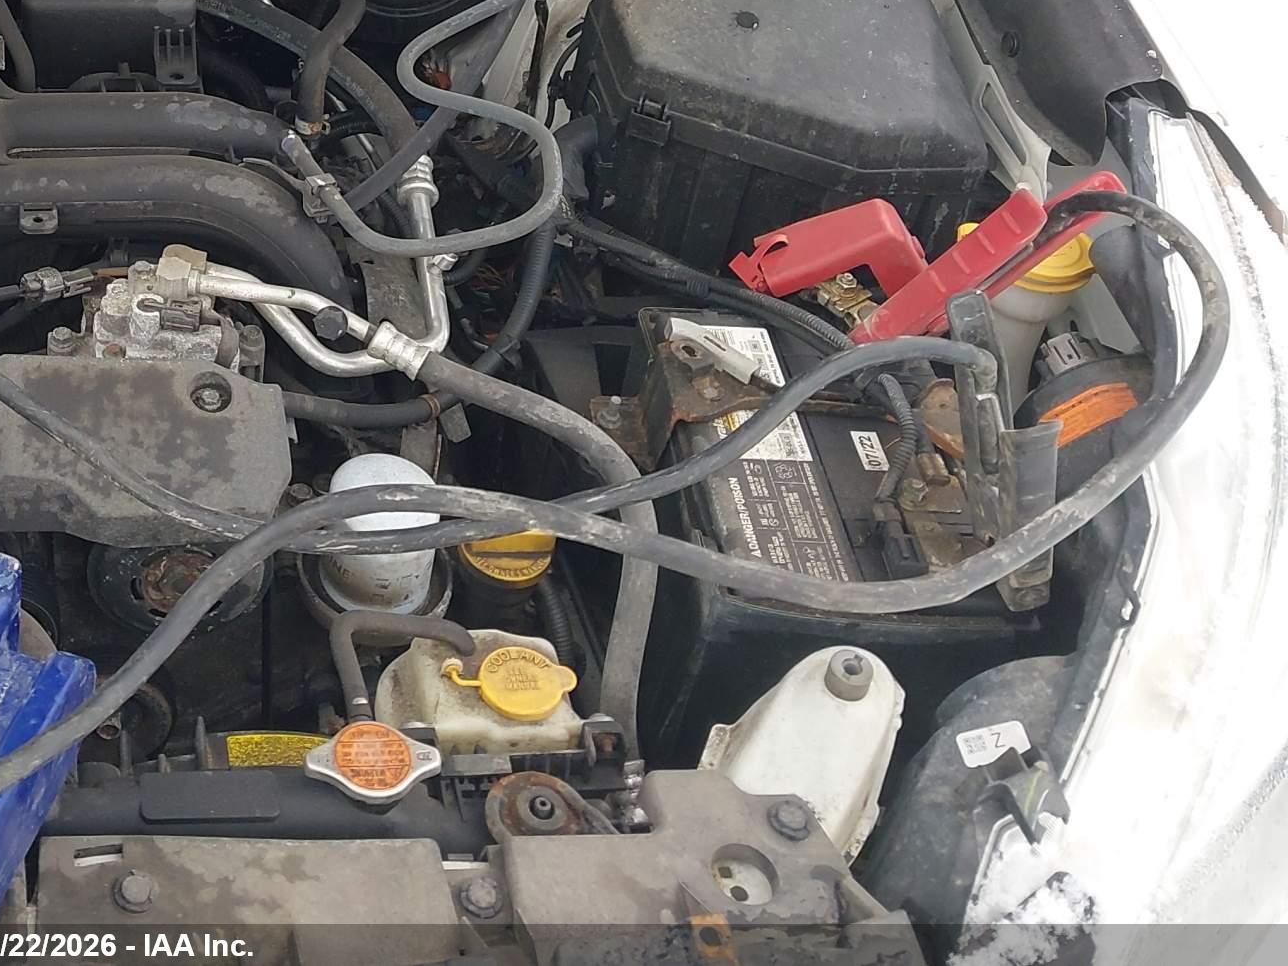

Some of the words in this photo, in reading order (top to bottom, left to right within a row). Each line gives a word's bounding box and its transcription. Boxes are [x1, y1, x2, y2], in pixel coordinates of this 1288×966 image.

[858, 436, 881, 466] 07/22
[728, 477, 758, 549] DANGER/POISON
[485, 648, 550, 674] COOLANT
[990, 732, 1006, 749] Z
